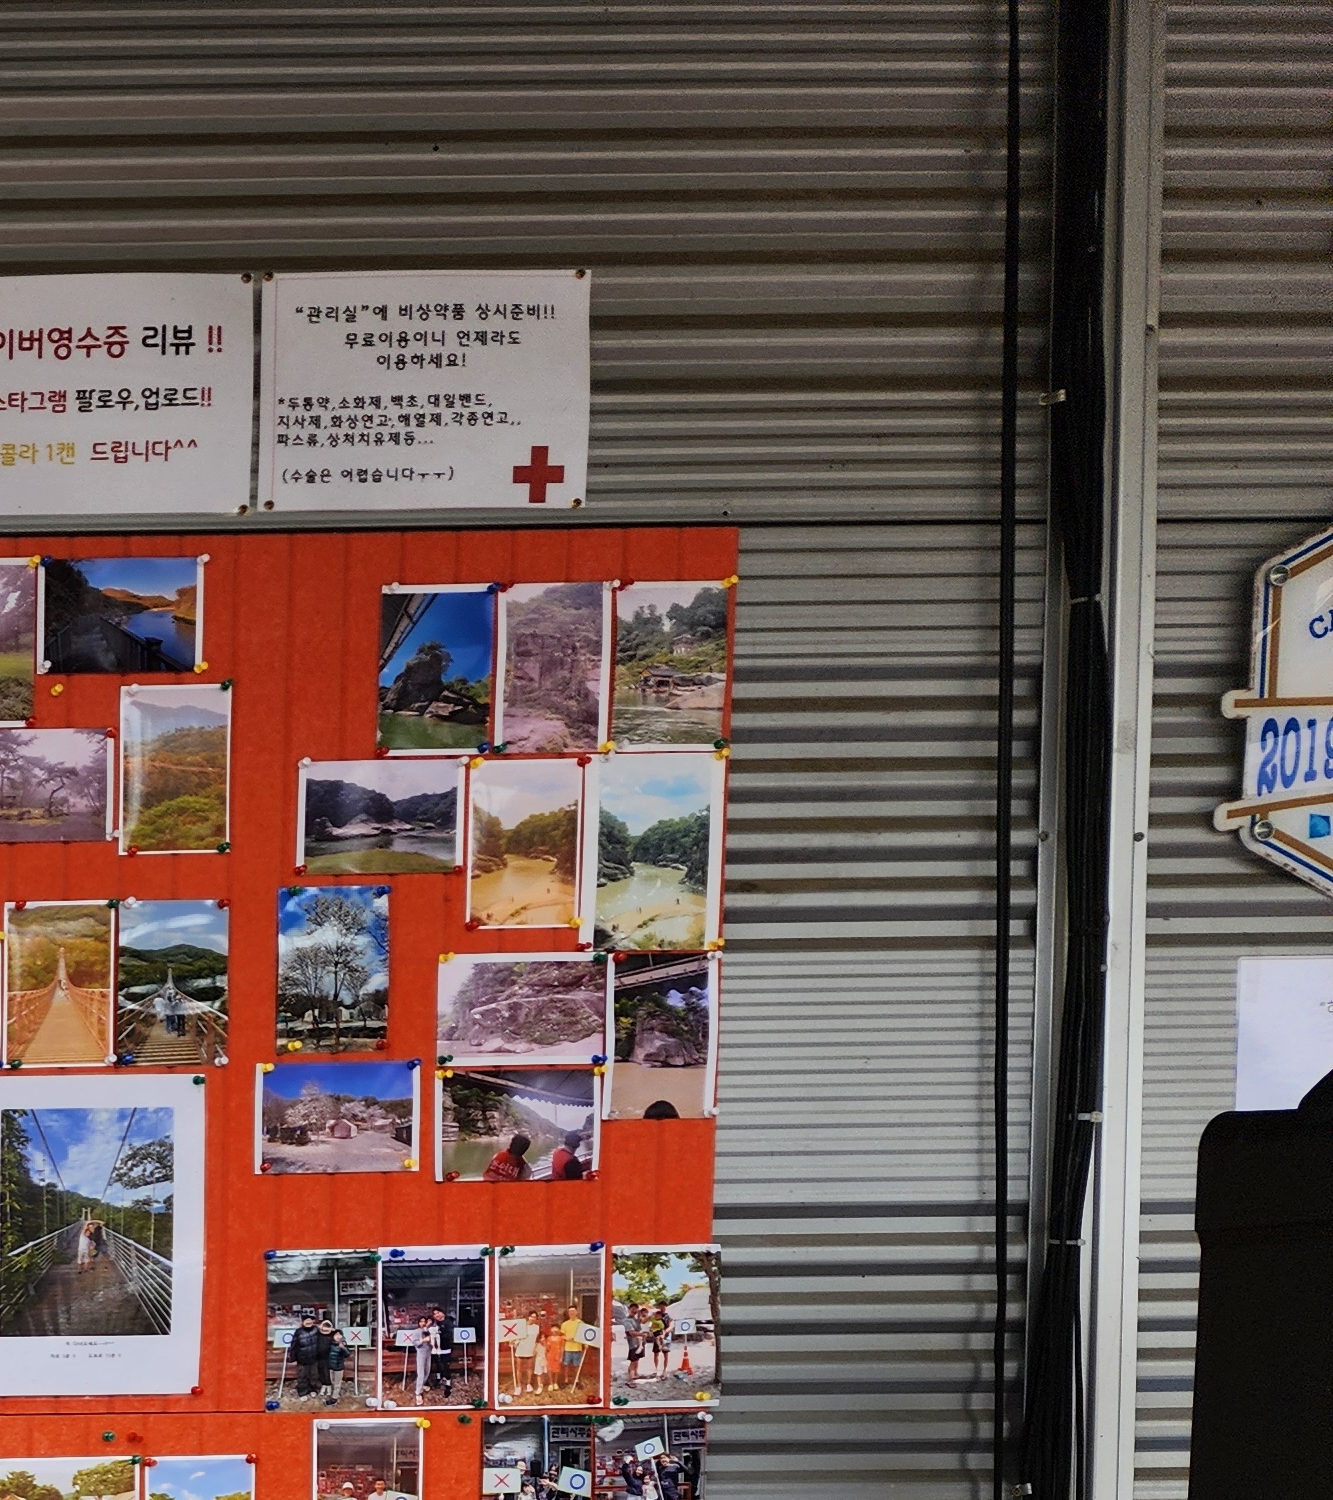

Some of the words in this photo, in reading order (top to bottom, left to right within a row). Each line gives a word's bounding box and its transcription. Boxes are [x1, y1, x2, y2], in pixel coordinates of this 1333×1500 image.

[398, 303, 466, 321] 비상약품
[474, 303, 556, 321] 상시준비!!
[141, 324, 197, 356] 리뷰
[344, 330, 447, 349] 무료이용이니
[455, 330, 522, 347] 언제라도
[376, 353, 468, 370] 이용하세요!
[46, 442, 75, 465] 1캔
[90, 438, 198, 464] 드립니다^^
[281, 466, 332, 485] (수술은
[1257, 716, 1333, 797] 2019
